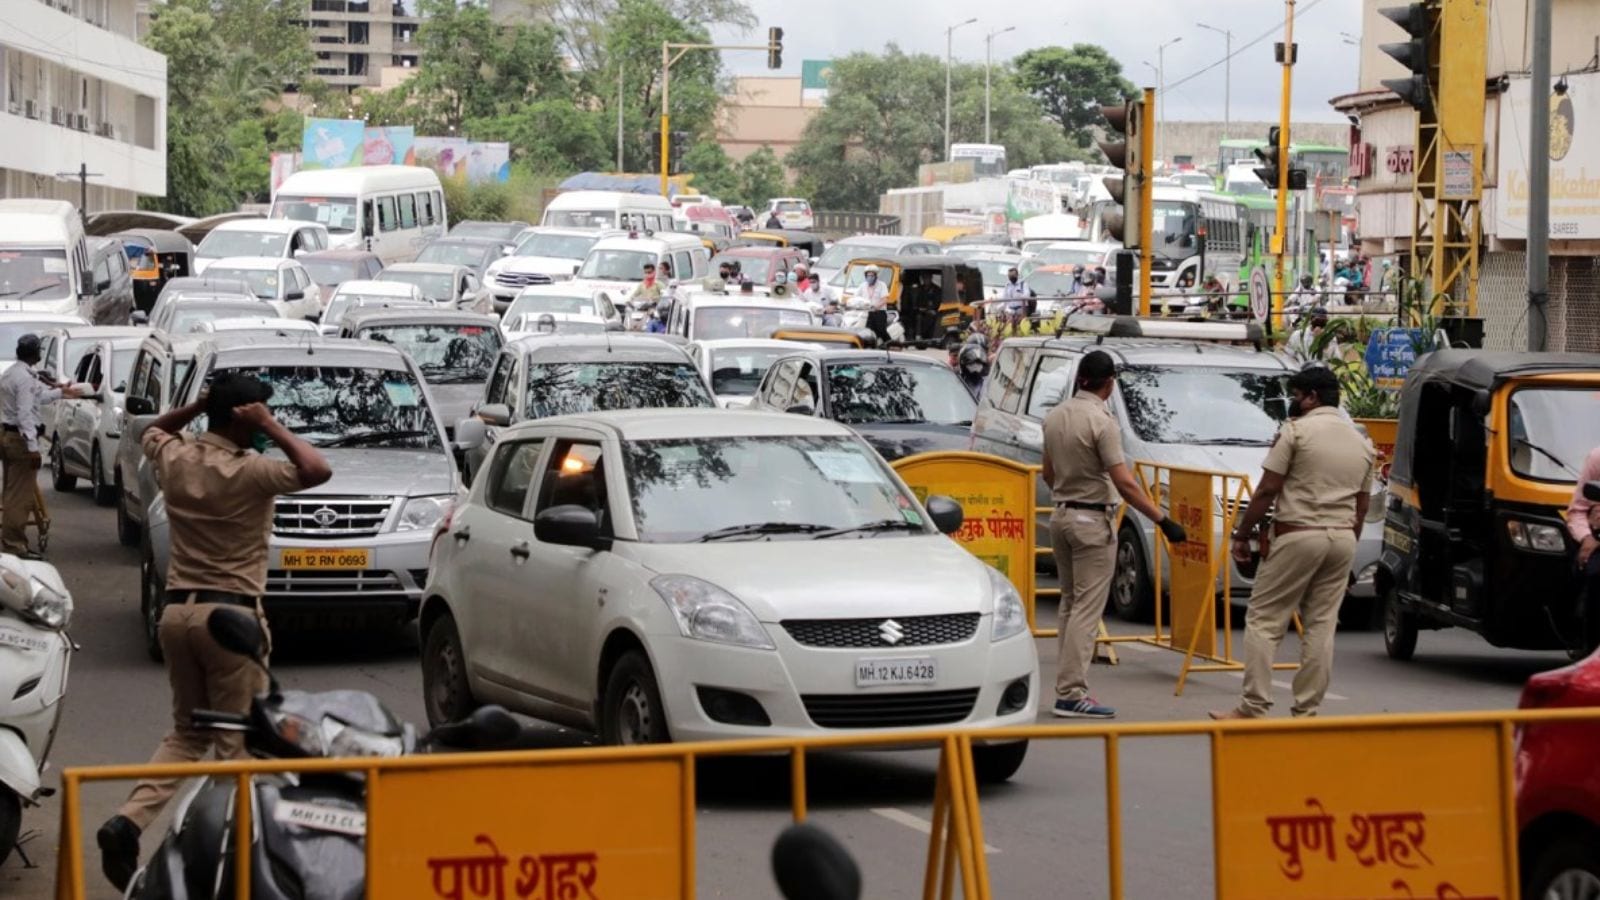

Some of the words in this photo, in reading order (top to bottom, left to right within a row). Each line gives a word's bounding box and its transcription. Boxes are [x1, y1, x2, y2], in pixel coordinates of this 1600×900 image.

[284, 555, 301, 566] MH
[305, 555, 316, 566] 12
[319, 555, 335, 566] RN
[338, 555, 367, 566] 0693
[427, 834, 509, 900] पणे
[1265, 798, 1337, 881] पुणे
[1345, 812, 1435, 869] शहर
